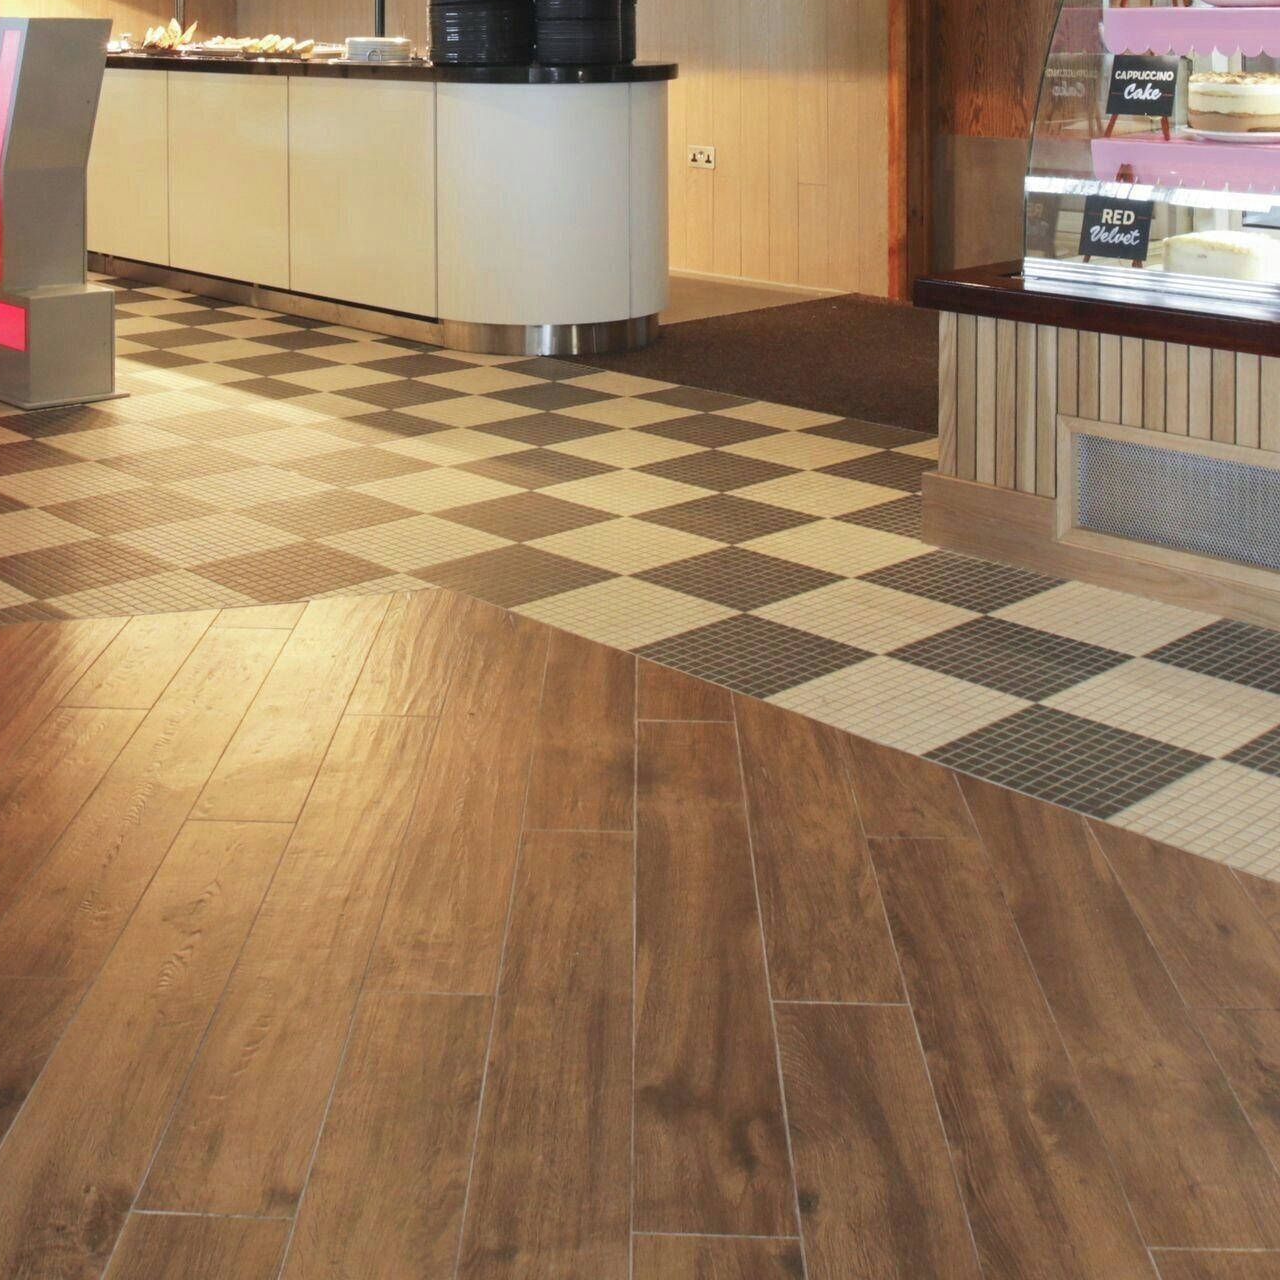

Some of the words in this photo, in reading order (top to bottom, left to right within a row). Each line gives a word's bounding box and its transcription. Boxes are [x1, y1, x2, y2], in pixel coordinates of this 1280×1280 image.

[1115, 70, 1174, 82] CAPPUCCINO
[1124, 83, 1162, 100] Cake
[1101, 209, 1135, 225] RED
[1090, 225, 1140, 245] Velvet
